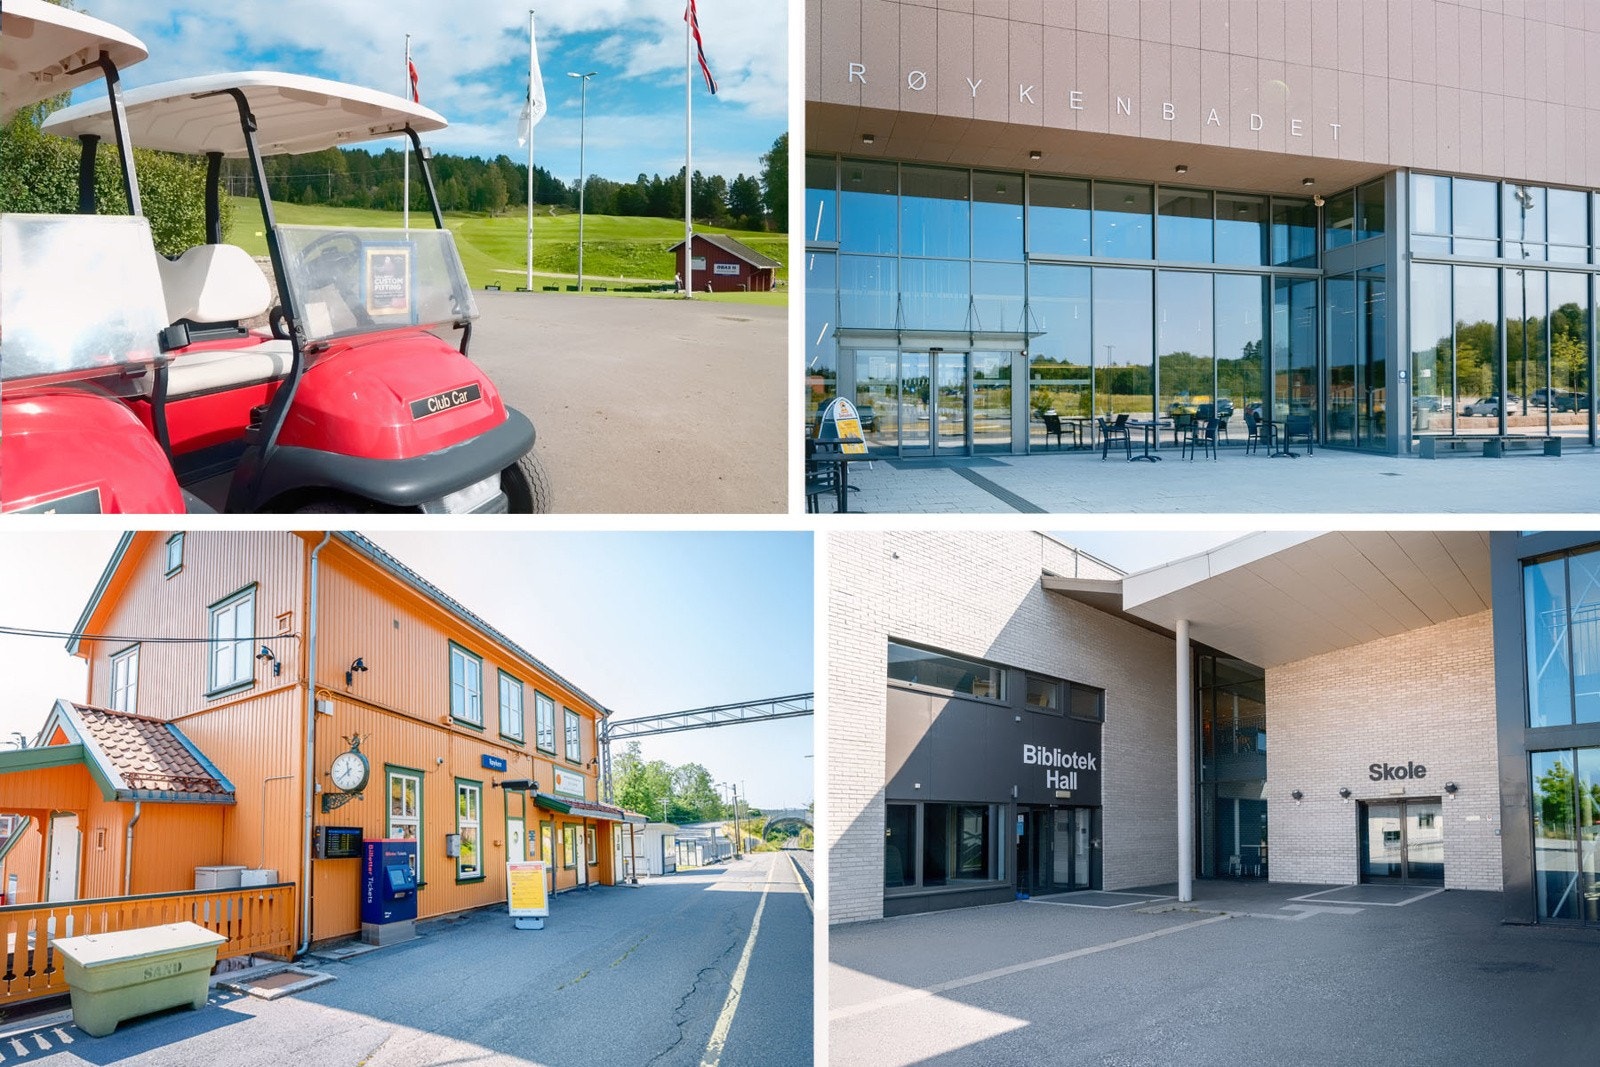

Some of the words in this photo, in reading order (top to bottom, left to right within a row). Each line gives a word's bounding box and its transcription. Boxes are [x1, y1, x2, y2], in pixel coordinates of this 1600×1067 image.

[848, 63, 1342, 141] RØYKENBADET
[427, 394, 451, 412] Club
[452, 391, 468, 404] Car
[1023, 744, 1097, 771] Bibliotek
[1046, 769, 1078, 790] Hall
[1368, 761, 1427, 781] Skole
[143, 962, 182, 980] SAND
